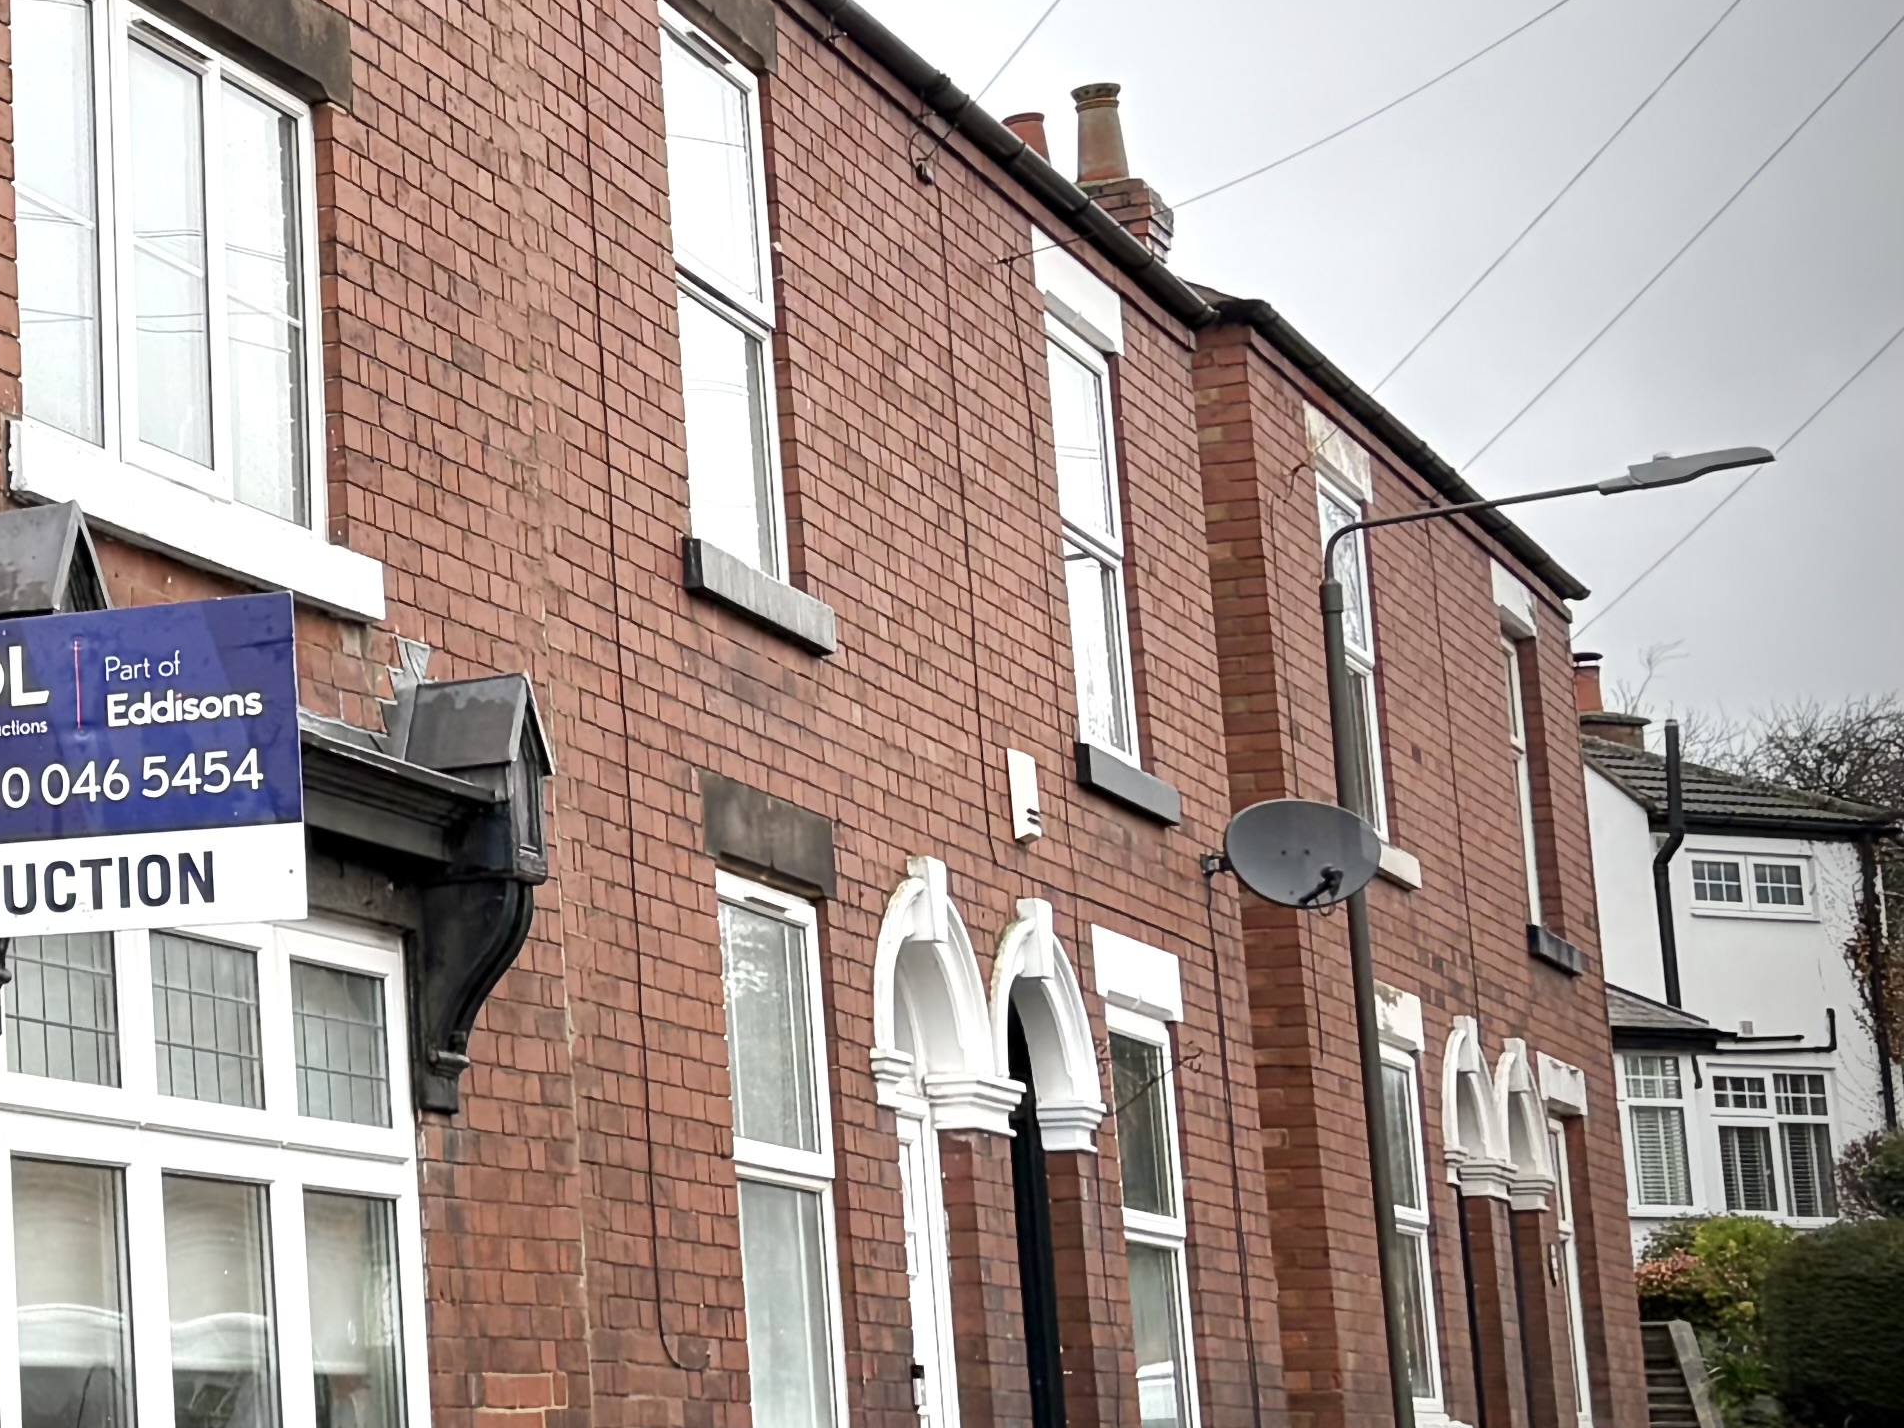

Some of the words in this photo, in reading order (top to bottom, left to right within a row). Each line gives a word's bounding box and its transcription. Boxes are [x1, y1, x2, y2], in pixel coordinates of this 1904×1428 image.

[104, 655, 151, 683] Part
[158, 650, 181, 677] of
[106, 690, 263, 727] Eddisons
[40, 759, 130, 807] 046
[142, 748, 264, 799] 5454
